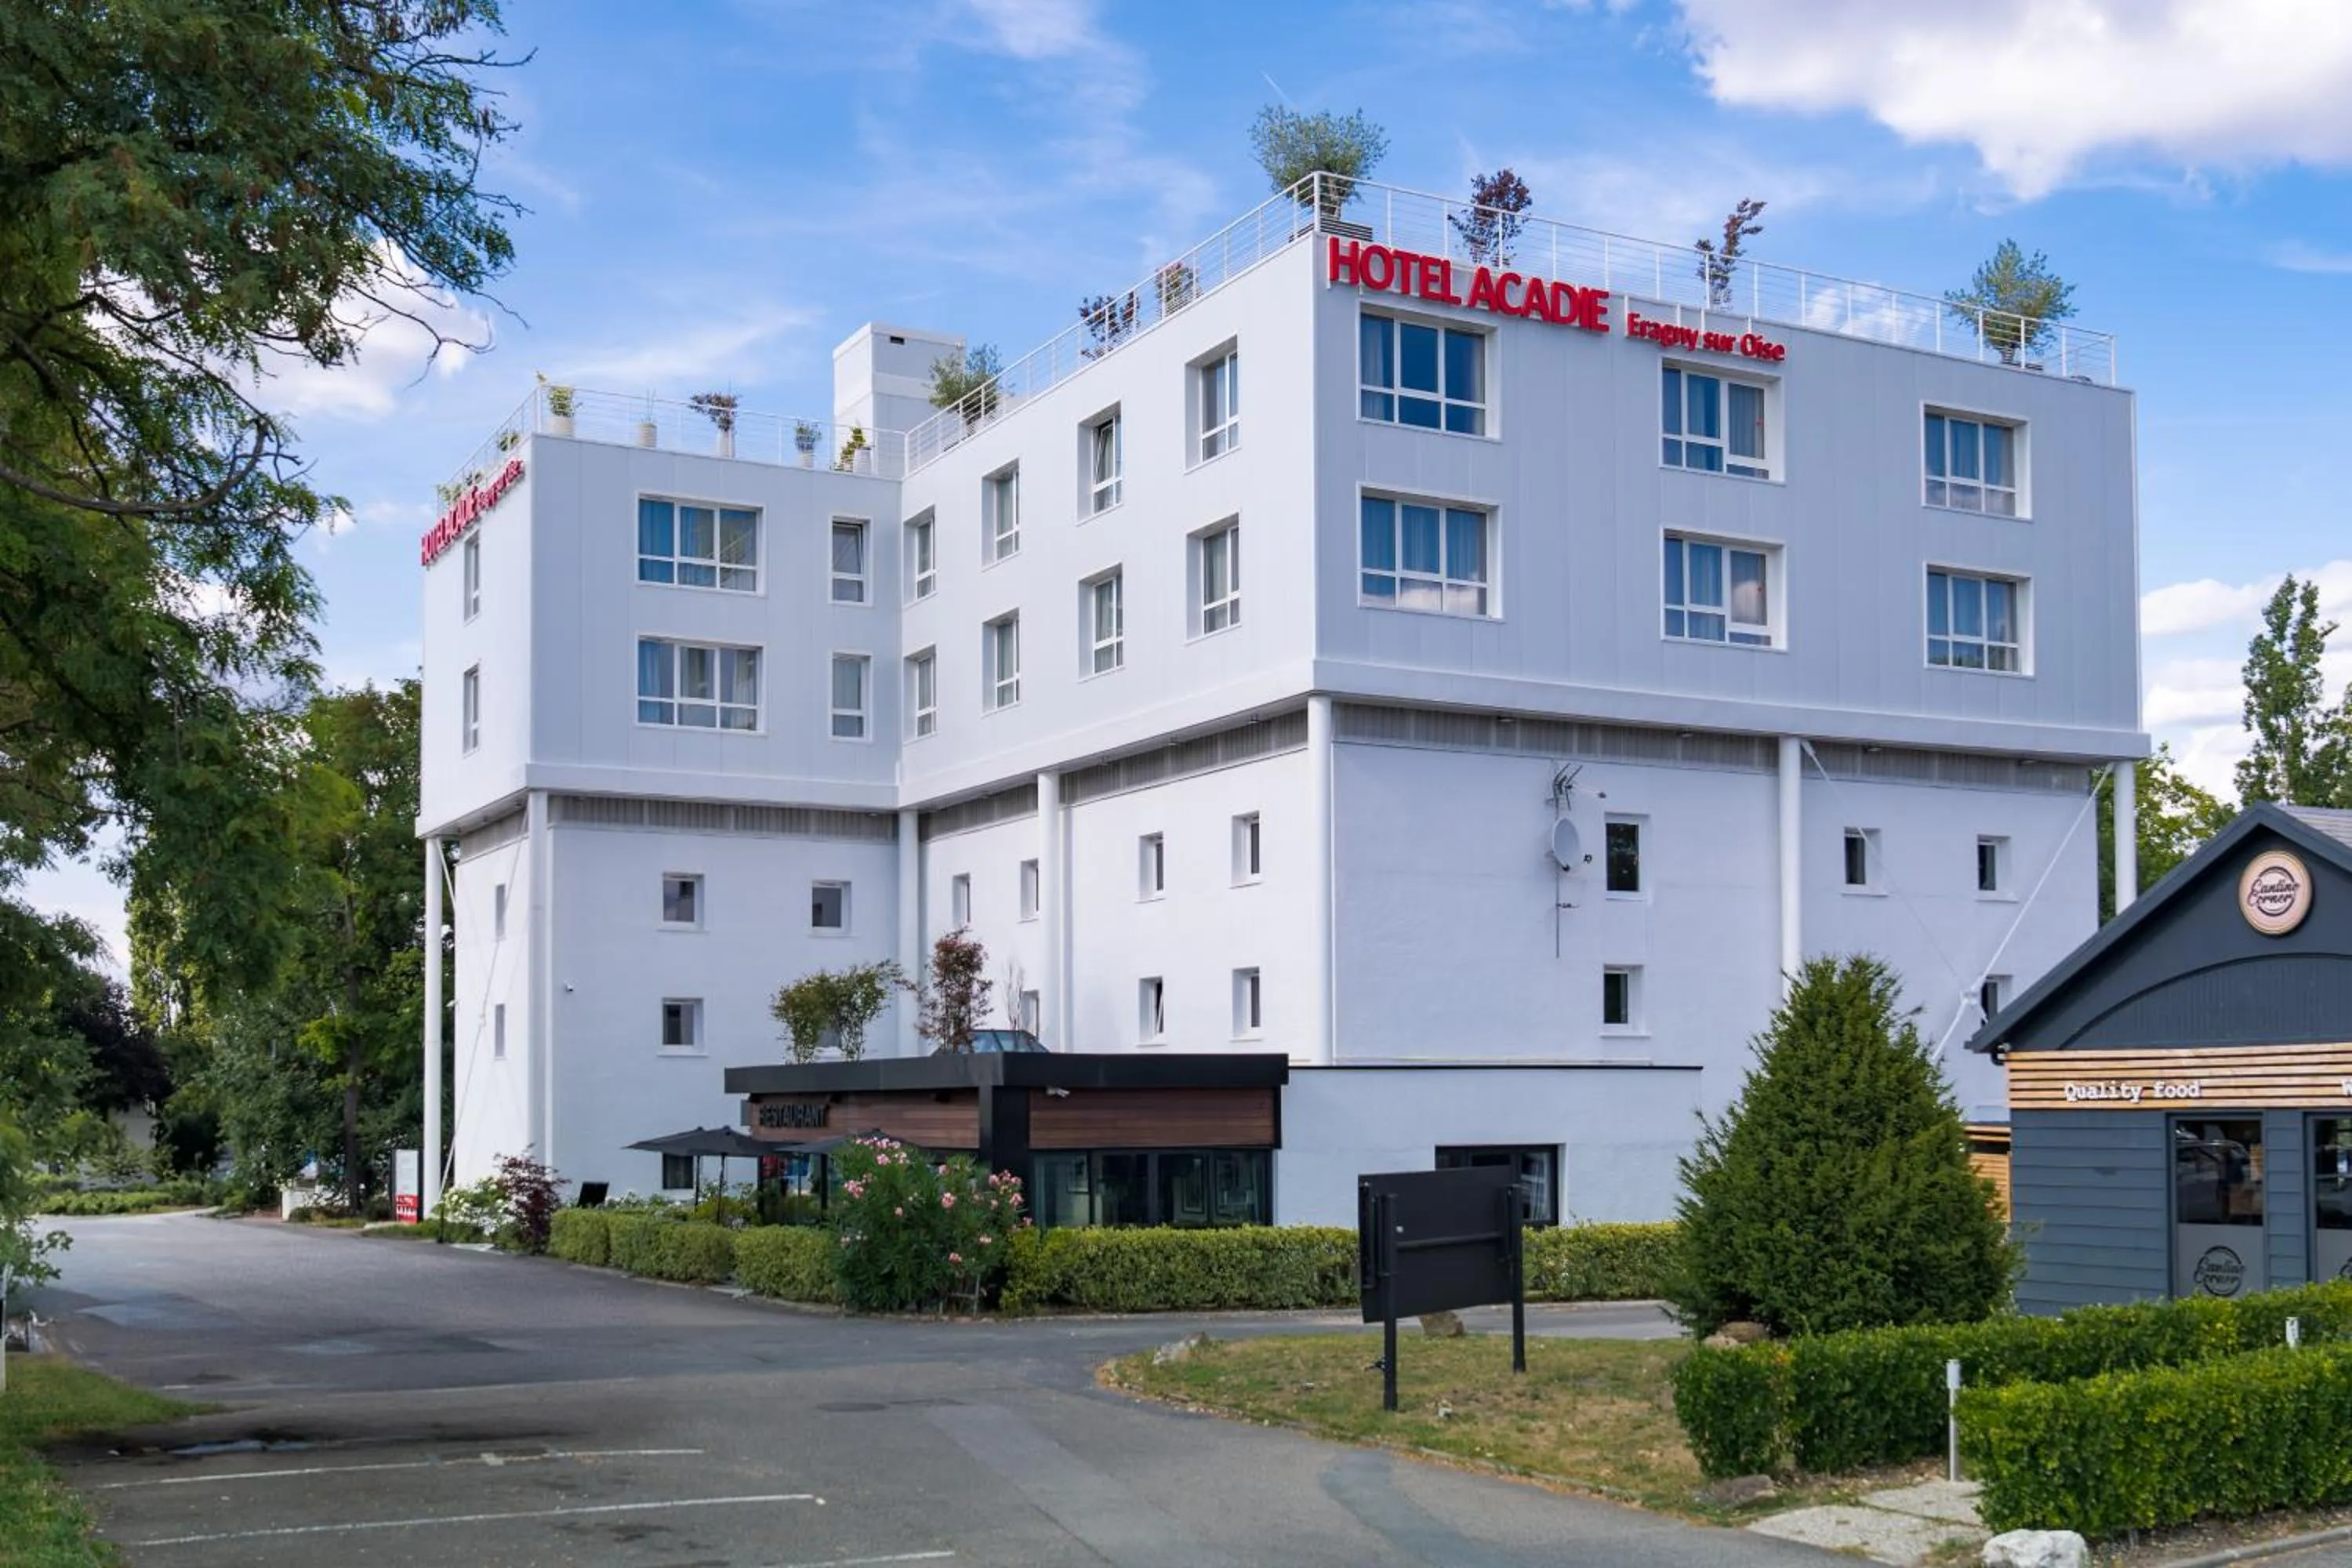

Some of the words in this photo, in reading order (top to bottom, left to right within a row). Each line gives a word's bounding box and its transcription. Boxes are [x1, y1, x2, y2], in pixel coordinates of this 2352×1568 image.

[1329, 237, 1462, 306] HOTEL
[1467, 266, 1610, 332] ACADIE
[1627, 312, 1699, 352] Eragny
[1703, 332, 1737, 352] sur
[1740, 333, 1785, 361] Oise
[2063, 1080, 2143, 1104] Quality
[2153, 1080, 2202, 1098] food
[759, 1103, 829, 1127] RESTAURANT
